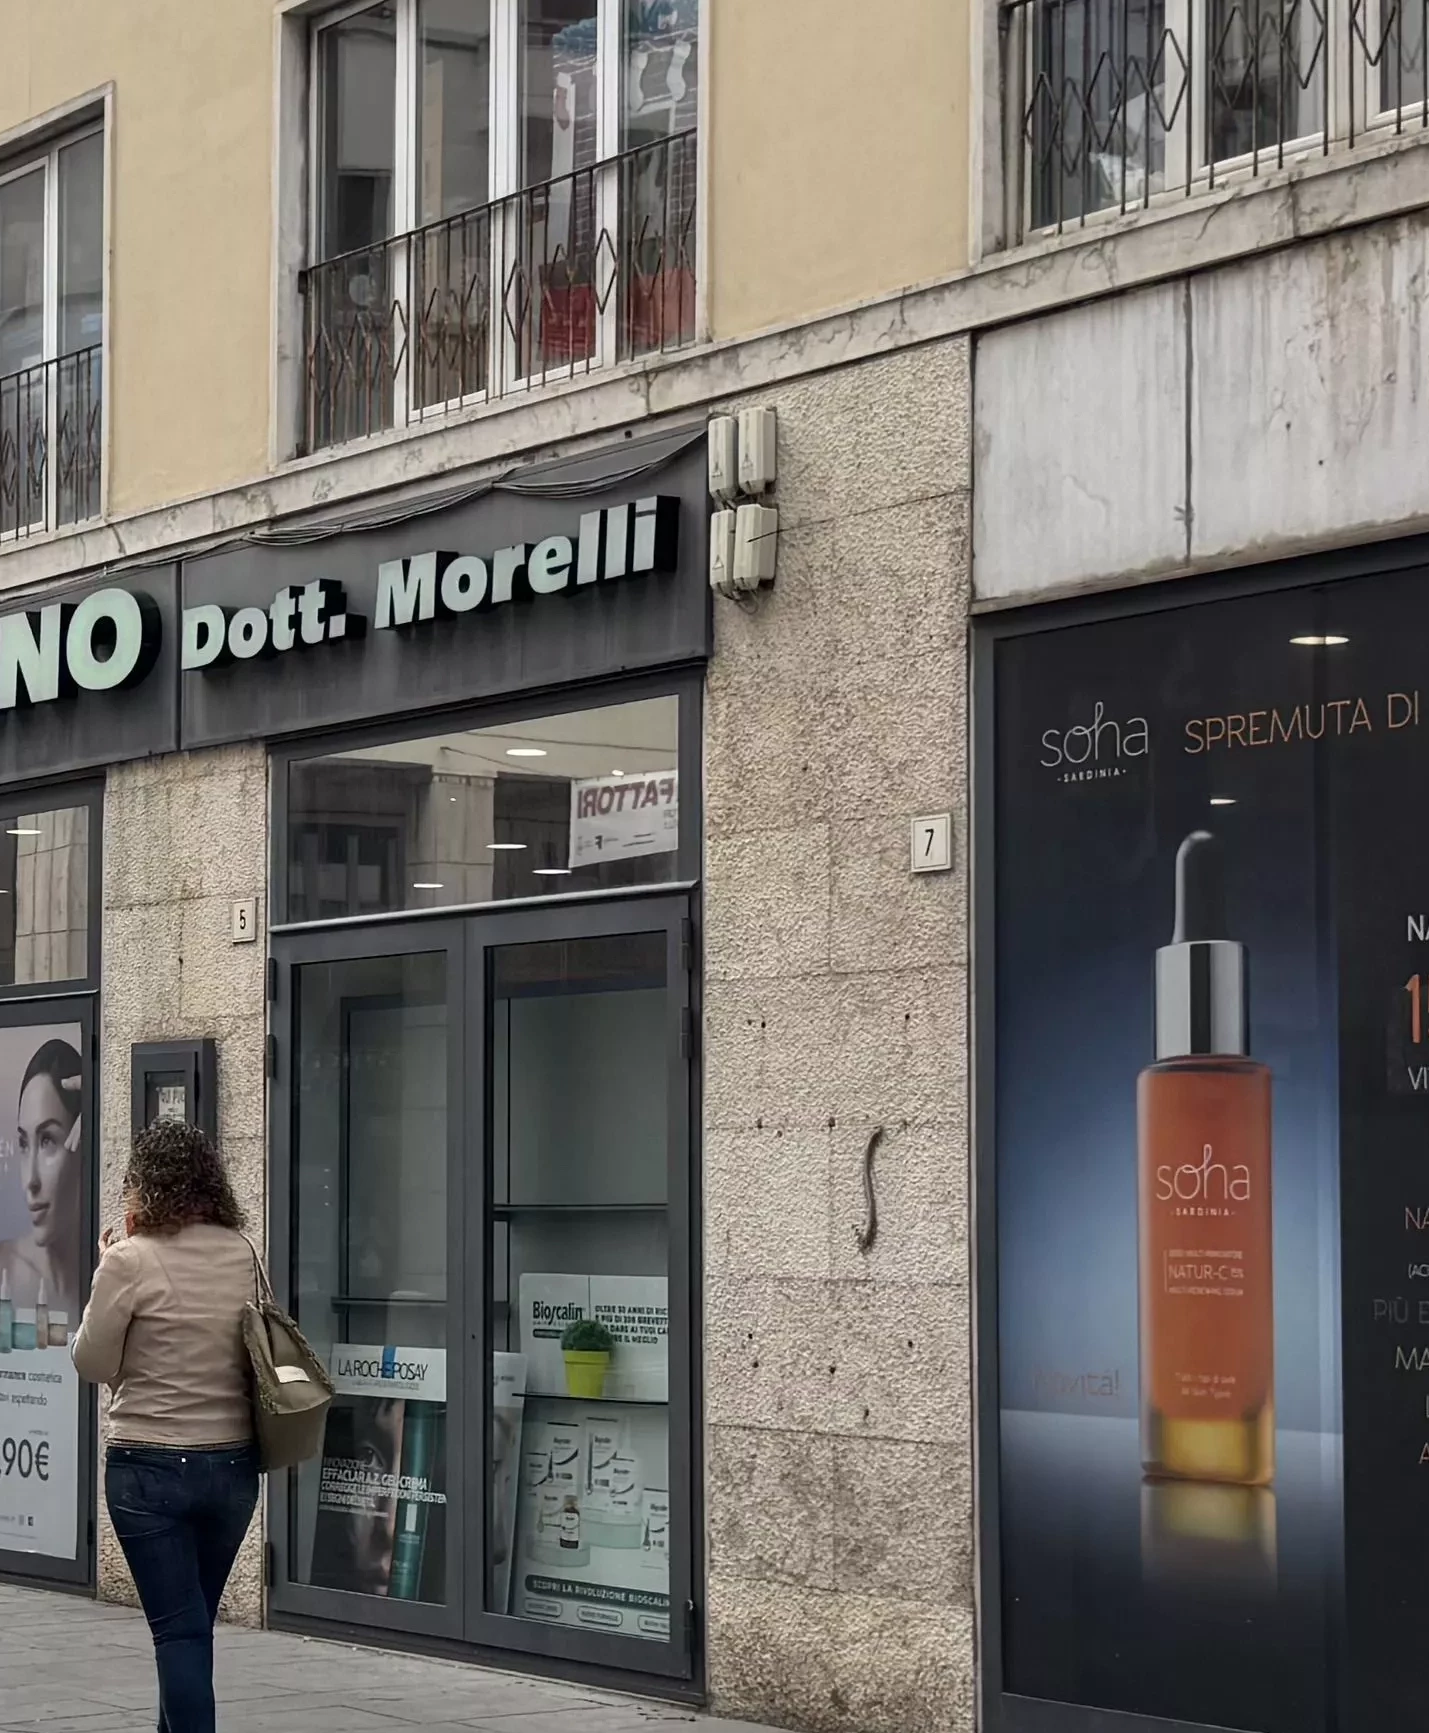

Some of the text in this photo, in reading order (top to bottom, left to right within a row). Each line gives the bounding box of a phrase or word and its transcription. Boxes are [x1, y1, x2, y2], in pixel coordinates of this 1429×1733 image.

[181, 579, 346, 670] Dott.
[374, 495, 658, 630] Morelli
[1041, 702, 1149, 768] soha
[1184, 698, 1372, 753] SPREMUTA
[1387, 690, 1420, 729] DI
[925, 828, 934, 857] 7
[239, 909, 246, 930] 5
[1156, 1143, 1251, 1201] soha
[1168, 1264, 1229, 1281] NATUR-C
[533, 1300, 583, 1325] Bioscalin
